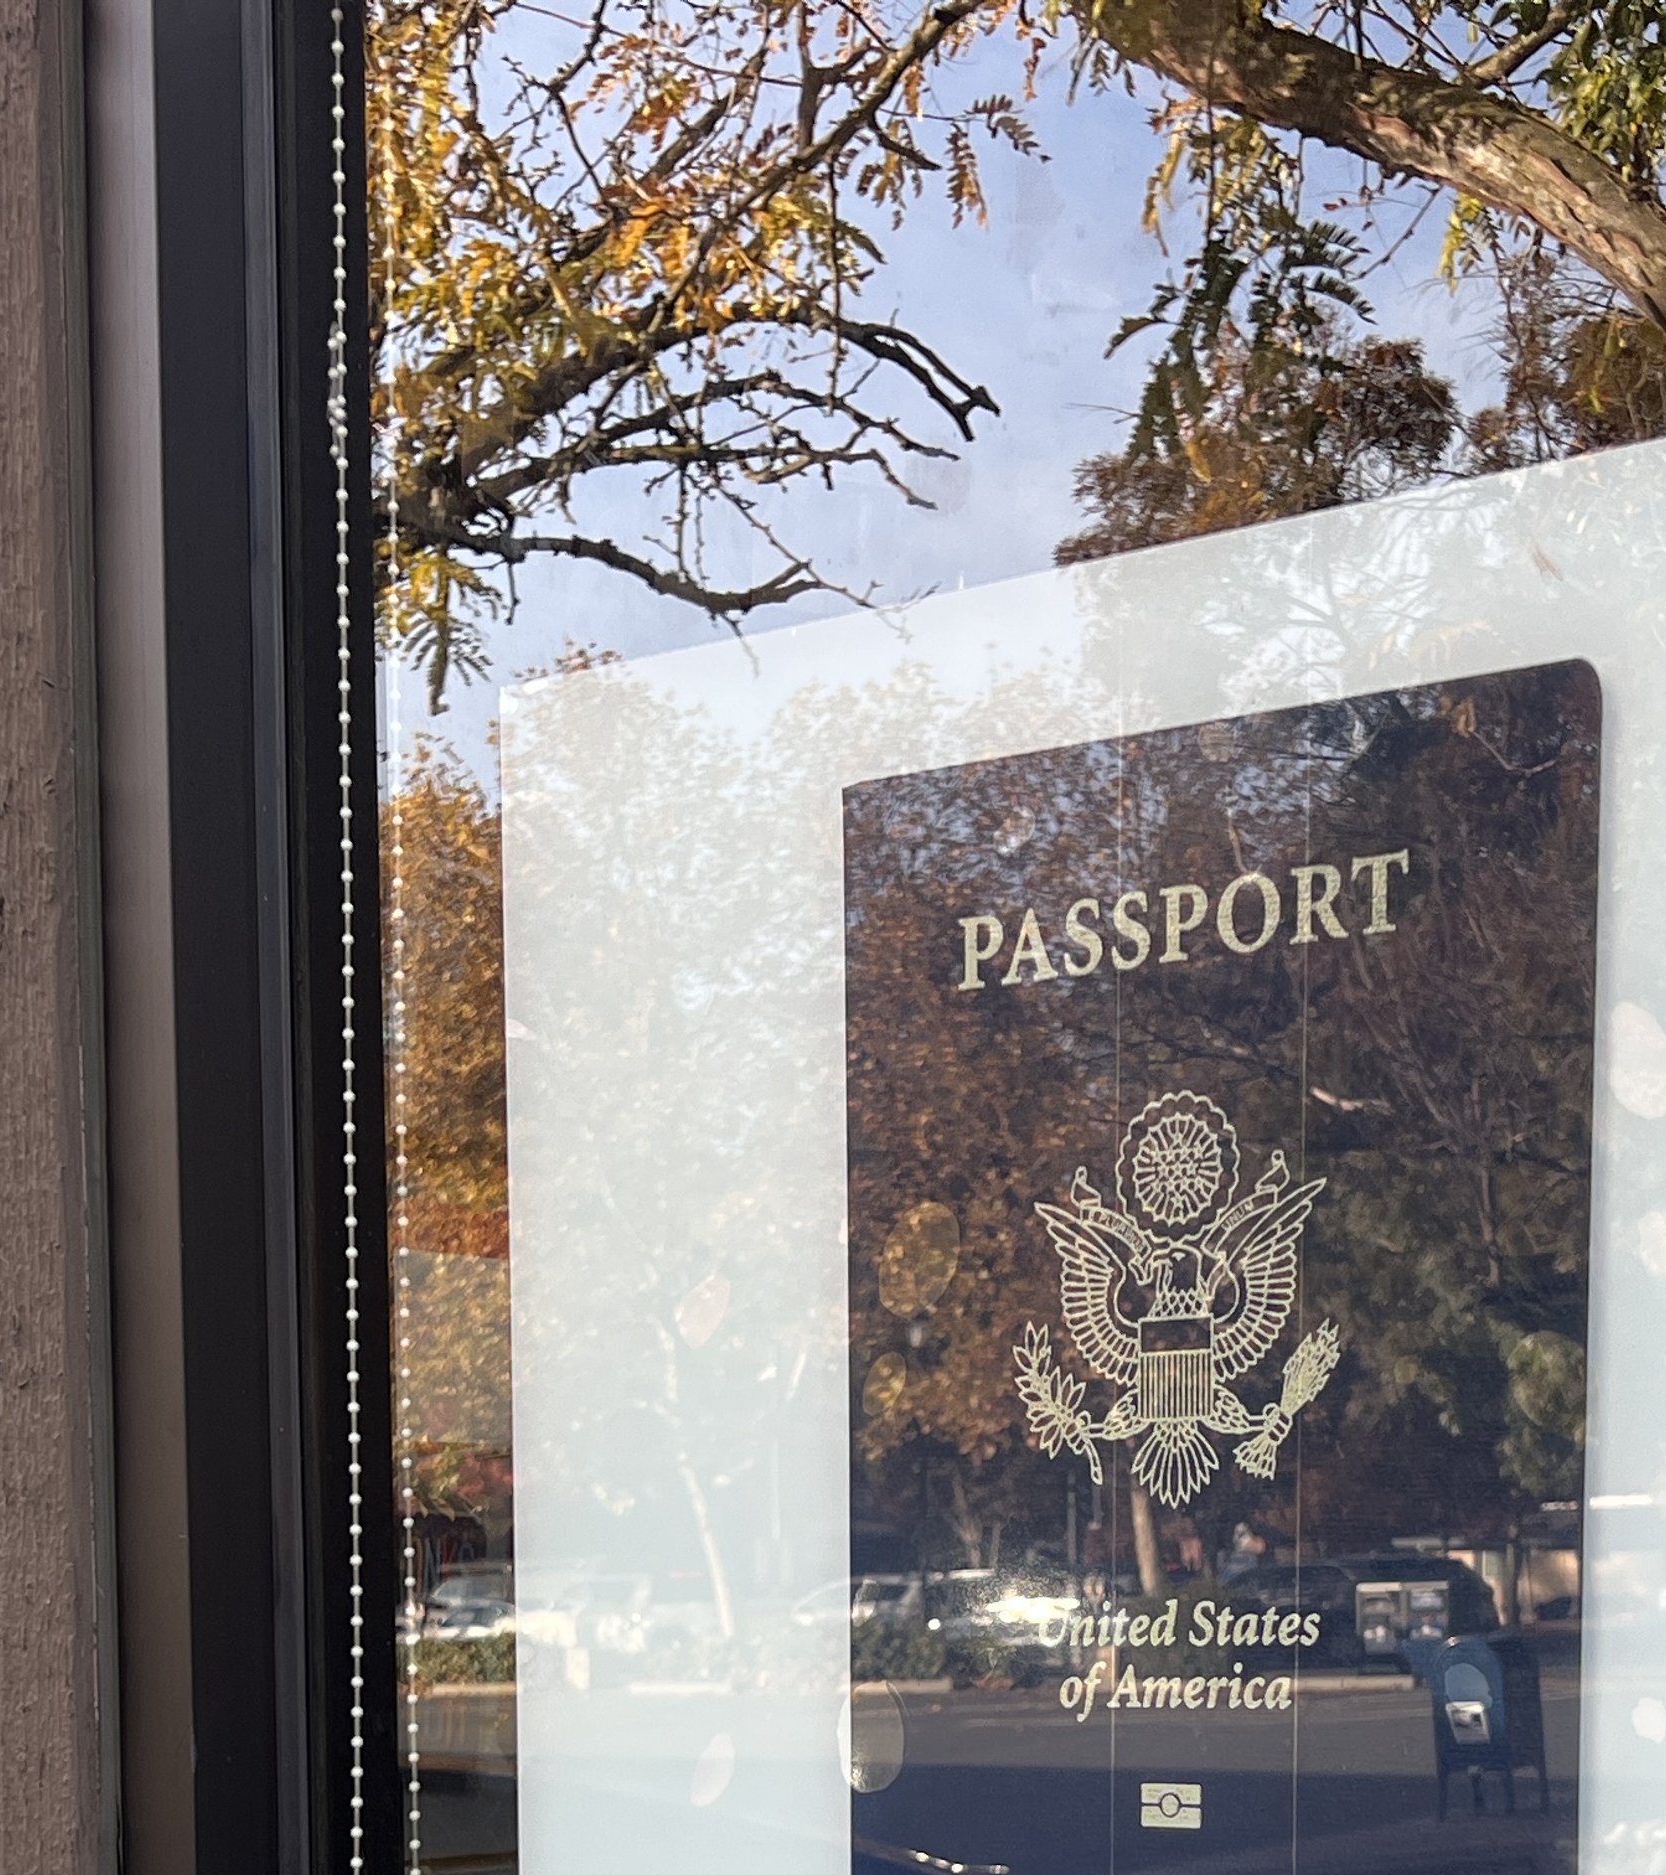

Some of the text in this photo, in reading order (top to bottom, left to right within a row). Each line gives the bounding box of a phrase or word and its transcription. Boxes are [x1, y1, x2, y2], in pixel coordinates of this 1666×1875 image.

[956, 848, 1411, 993] PASSPORT
[1038, 1597, 1322, 1649] United States
[1059, 1661, 1293, 1723] of America
